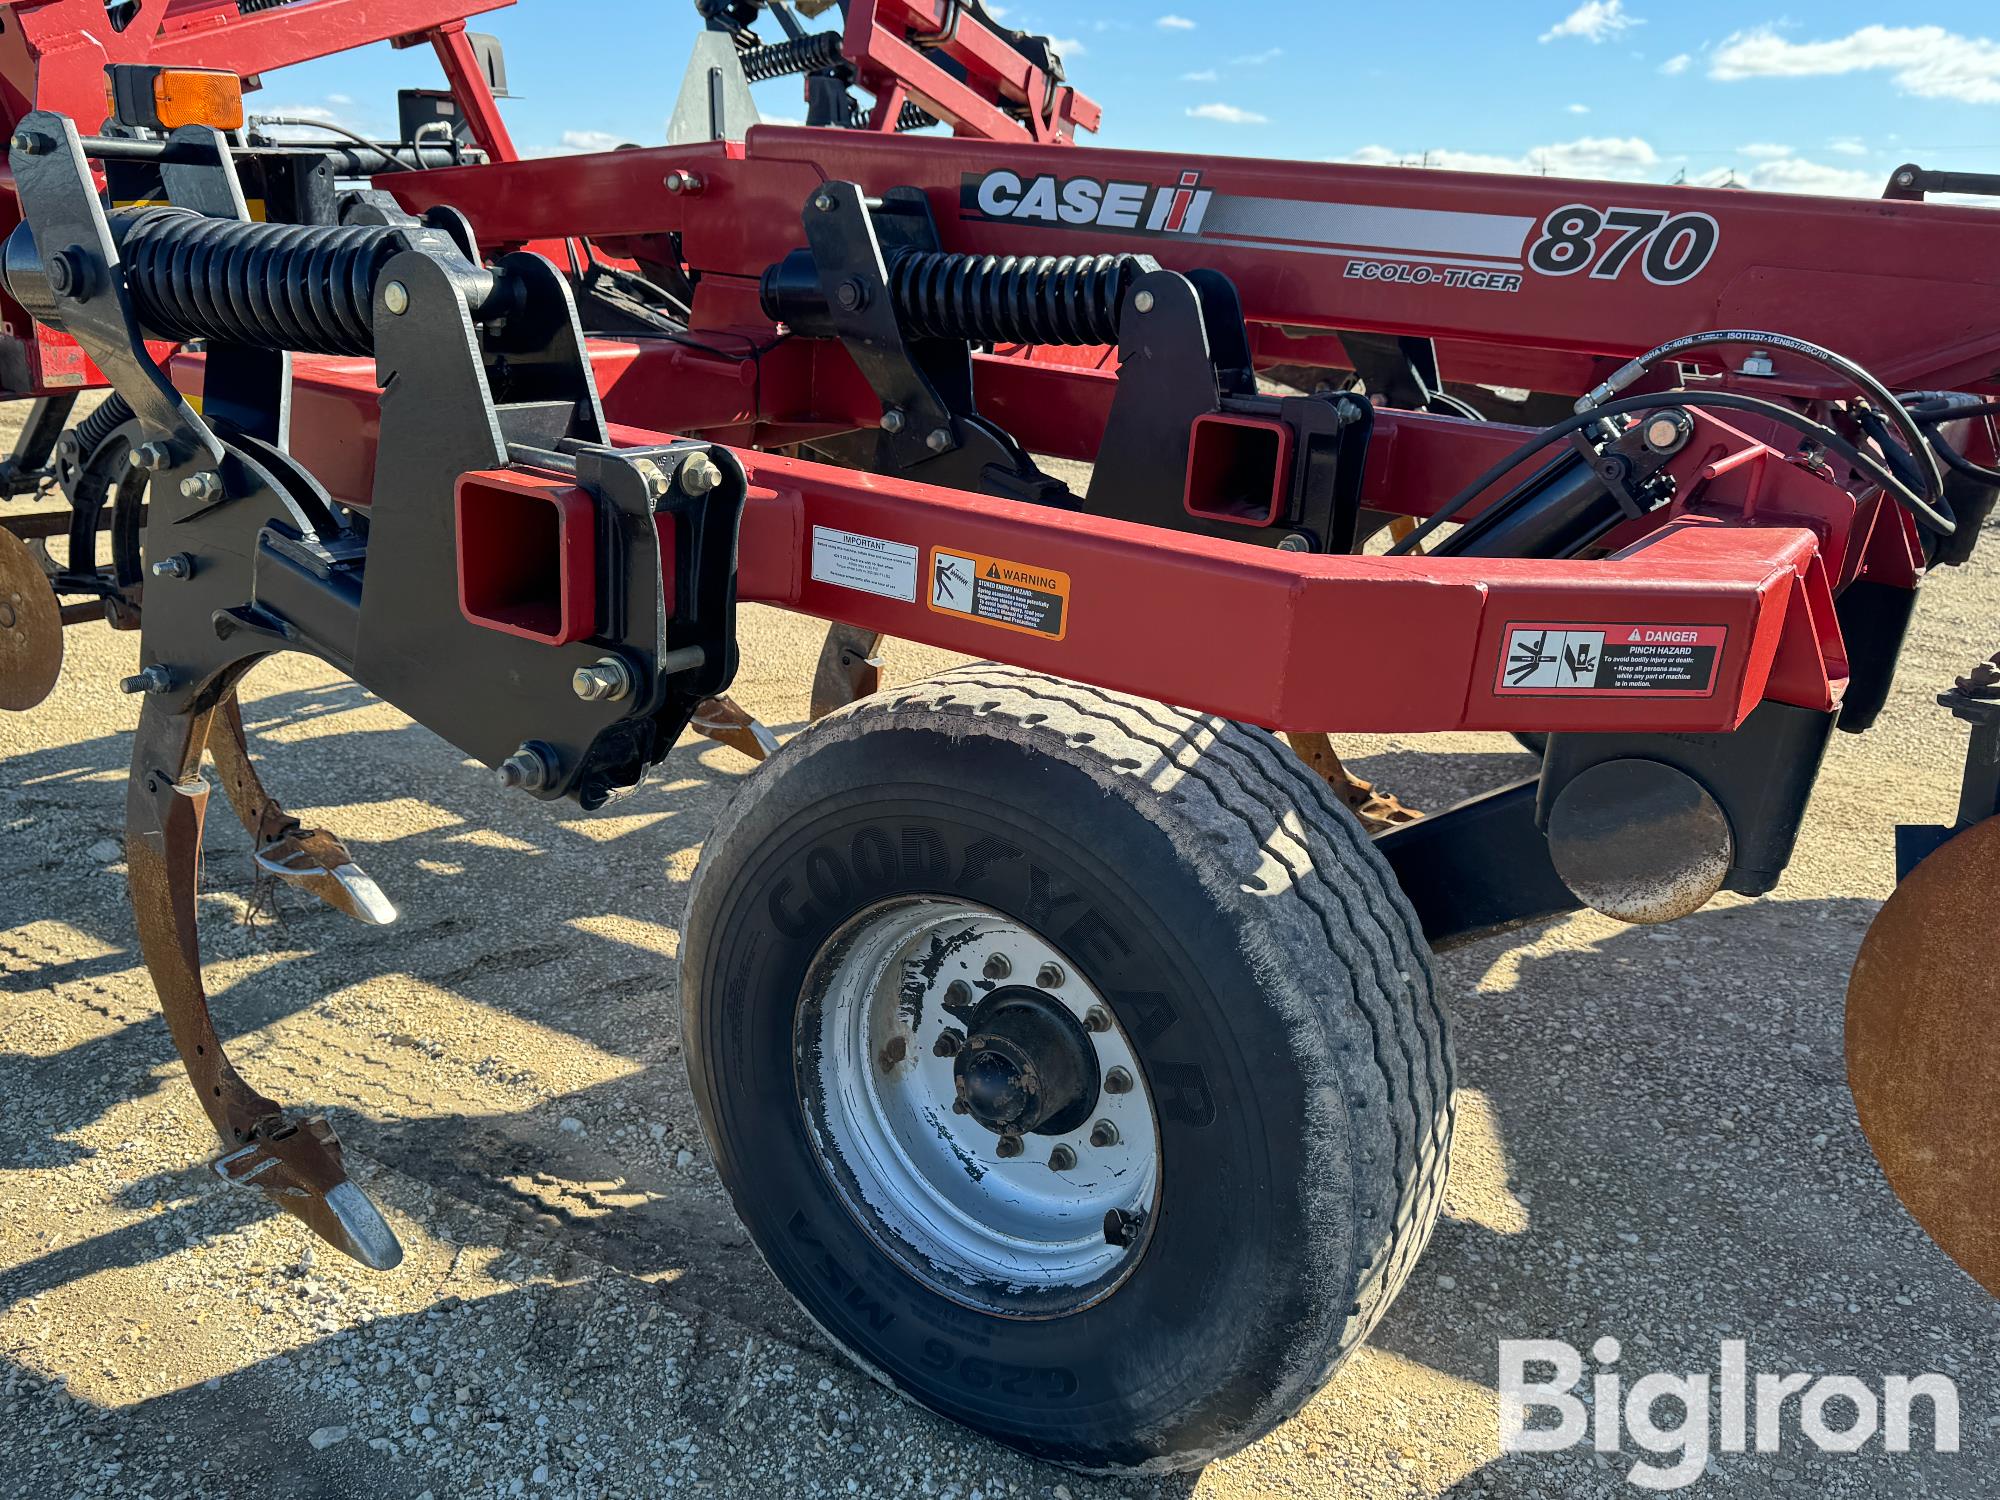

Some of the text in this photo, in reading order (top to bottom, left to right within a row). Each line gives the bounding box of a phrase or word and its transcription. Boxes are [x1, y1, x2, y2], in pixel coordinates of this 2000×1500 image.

[977, 171, 1149, 229] CASE
[1527, 203, 1720, 286] 870
[1343, 260, 1523, 293] ECOLO-TIGER
[843, 535, 886, 551] IMPORTANT
[1003, 569, 1056, 589] WARNING
[1645, 631, 1698, 643] DANGER
[1629, 646, 1692, 655] PINCH HAZARD
[1630, 655, 1649, 664] bodily
[1649, 656, 1667, 665] injury
[1617, 665, 1634, 674] Keep
[1643, 666, 1668, 674] persons
[1668, 666, 1684, 674] away
[1628, 680, 1651, 688] motion.
[1644, 673, 1658, 681] part
[768, 824, 1218, 1129] GOODYEAR
